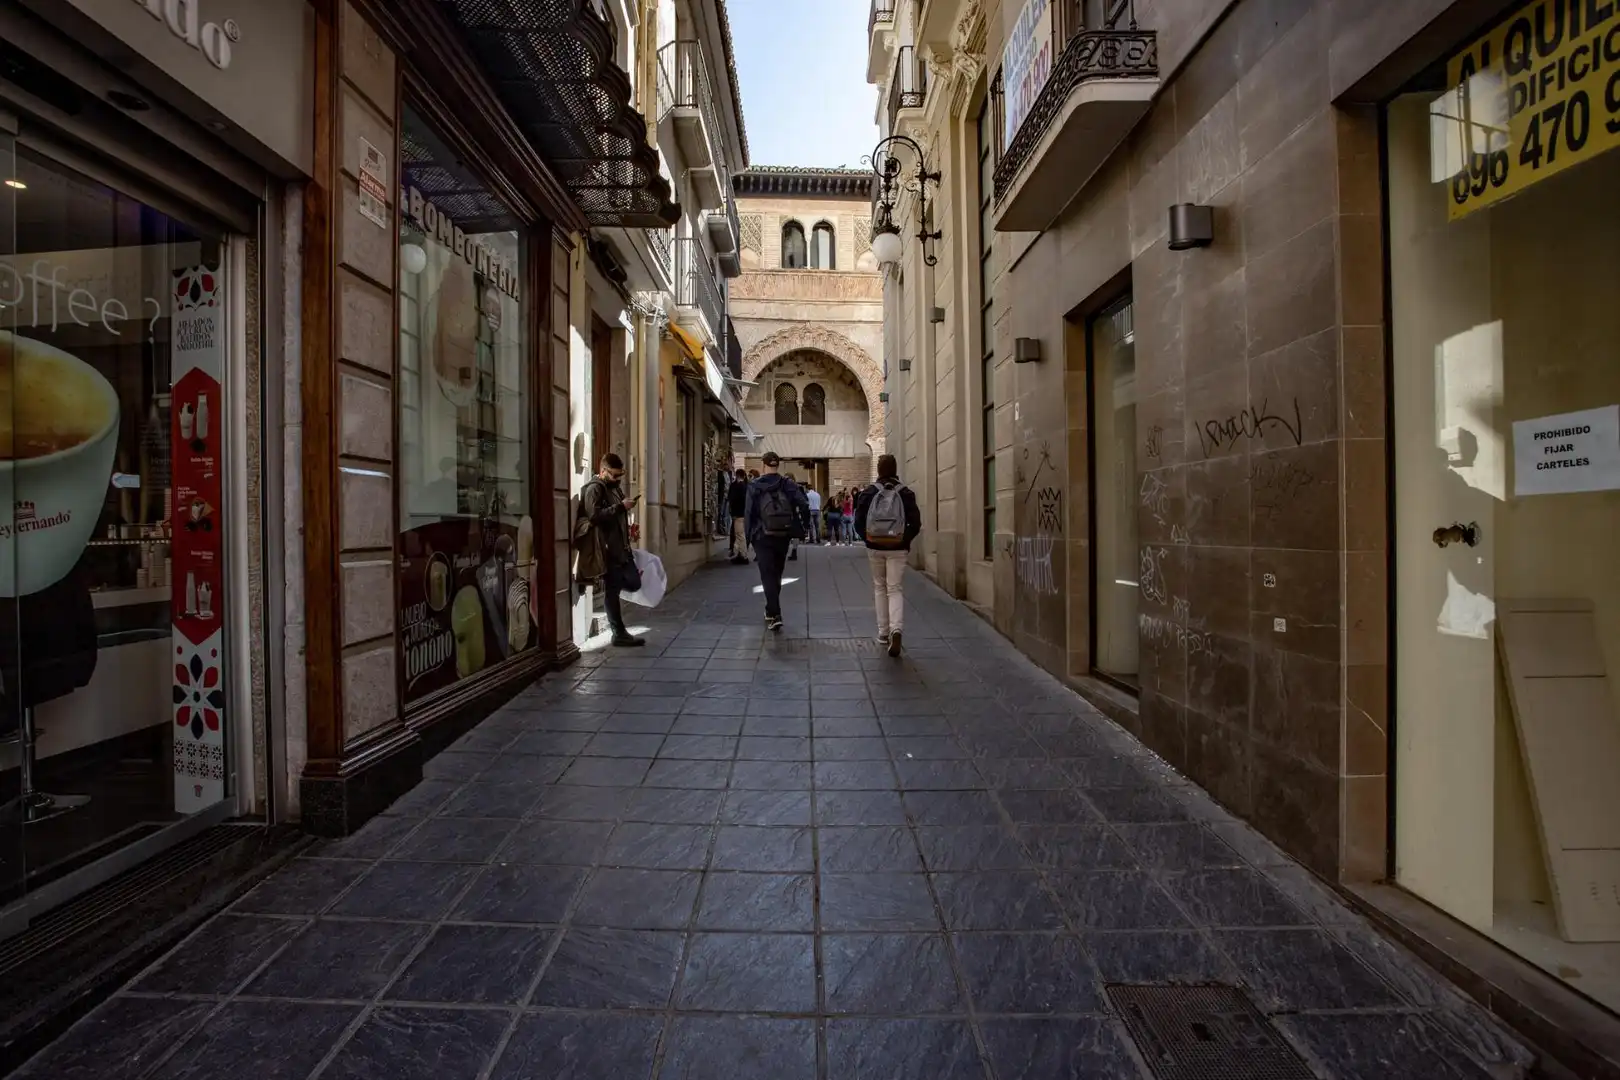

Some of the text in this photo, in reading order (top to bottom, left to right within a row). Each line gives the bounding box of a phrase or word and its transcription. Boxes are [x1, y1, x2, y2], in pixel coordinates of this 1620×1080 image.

[1519, 90, 1590, 170] 470
[1533, 425, 1591, 440] PROHIBIDO
[1544, 443, 1574, 455] FIJAR
[1536, 457, 1590, 471] CARTELES
